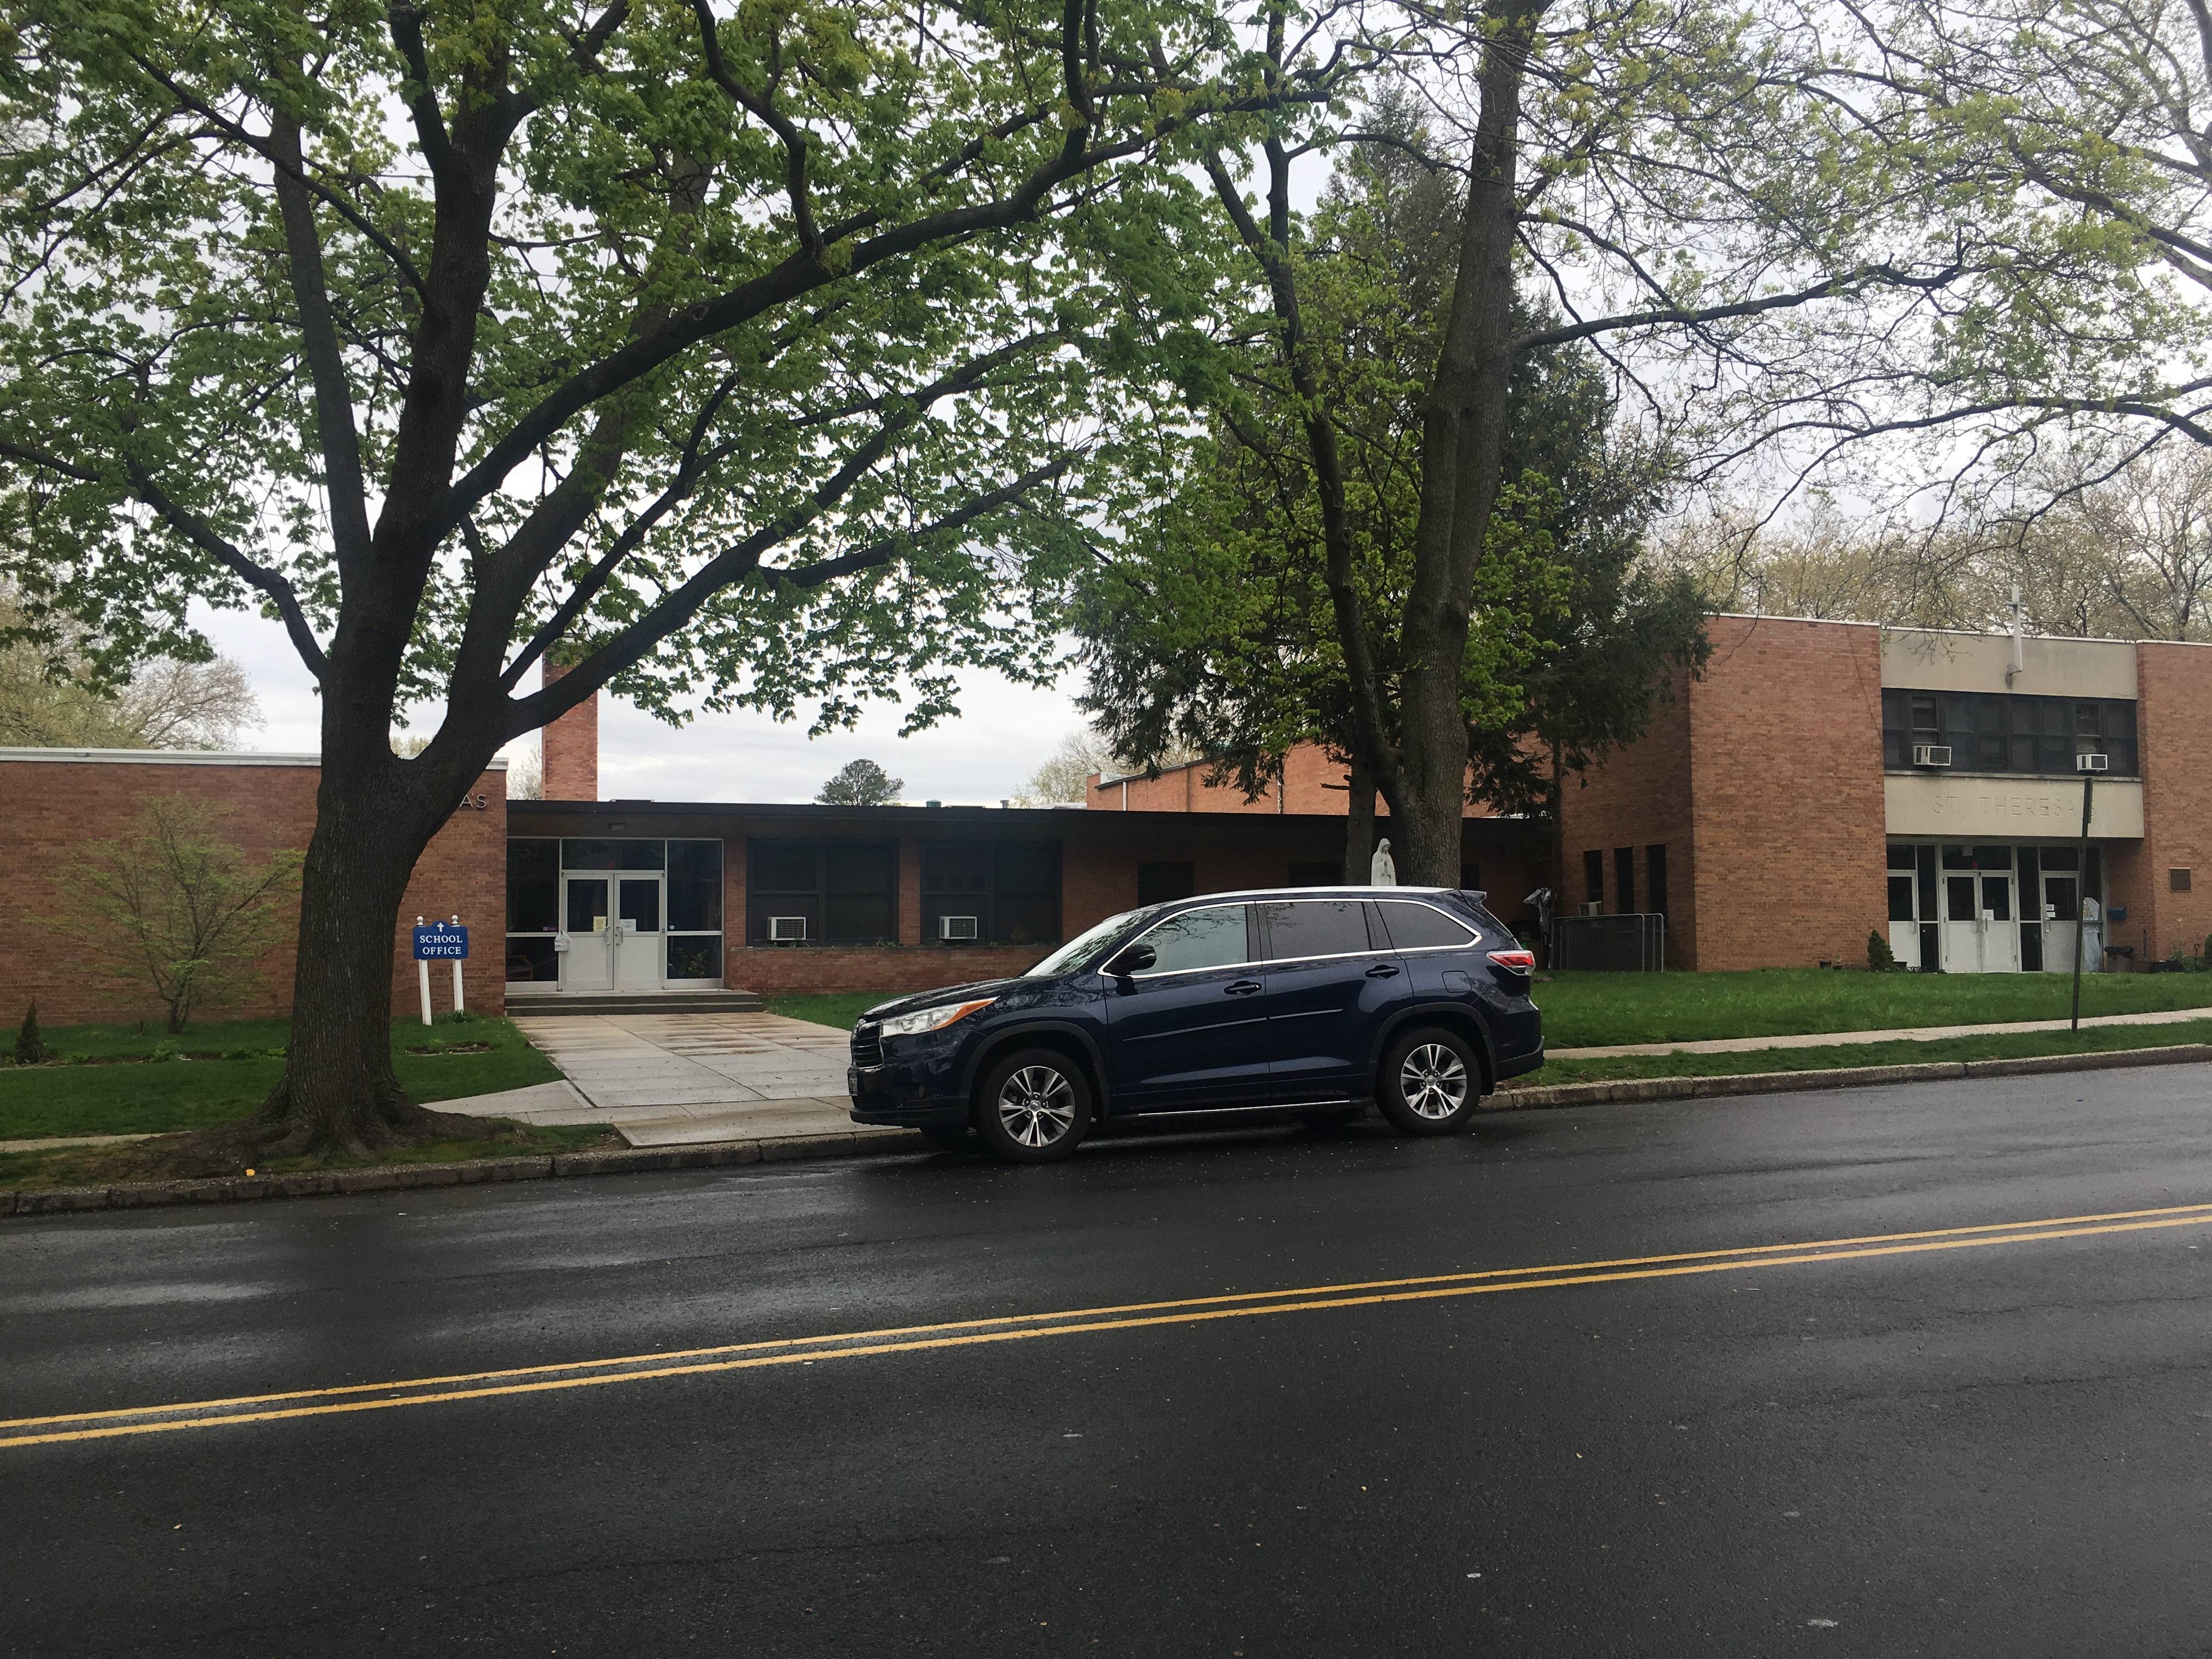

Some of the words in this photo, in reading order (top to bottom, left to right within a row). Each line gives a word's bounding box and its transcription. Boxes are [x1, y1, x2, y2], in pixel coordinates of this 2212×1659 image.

[1932, 795, 1960, 815] ST.
[420, 935, 463, 944] SCHOOL
[422, 946, 462, 955] OFFICE
